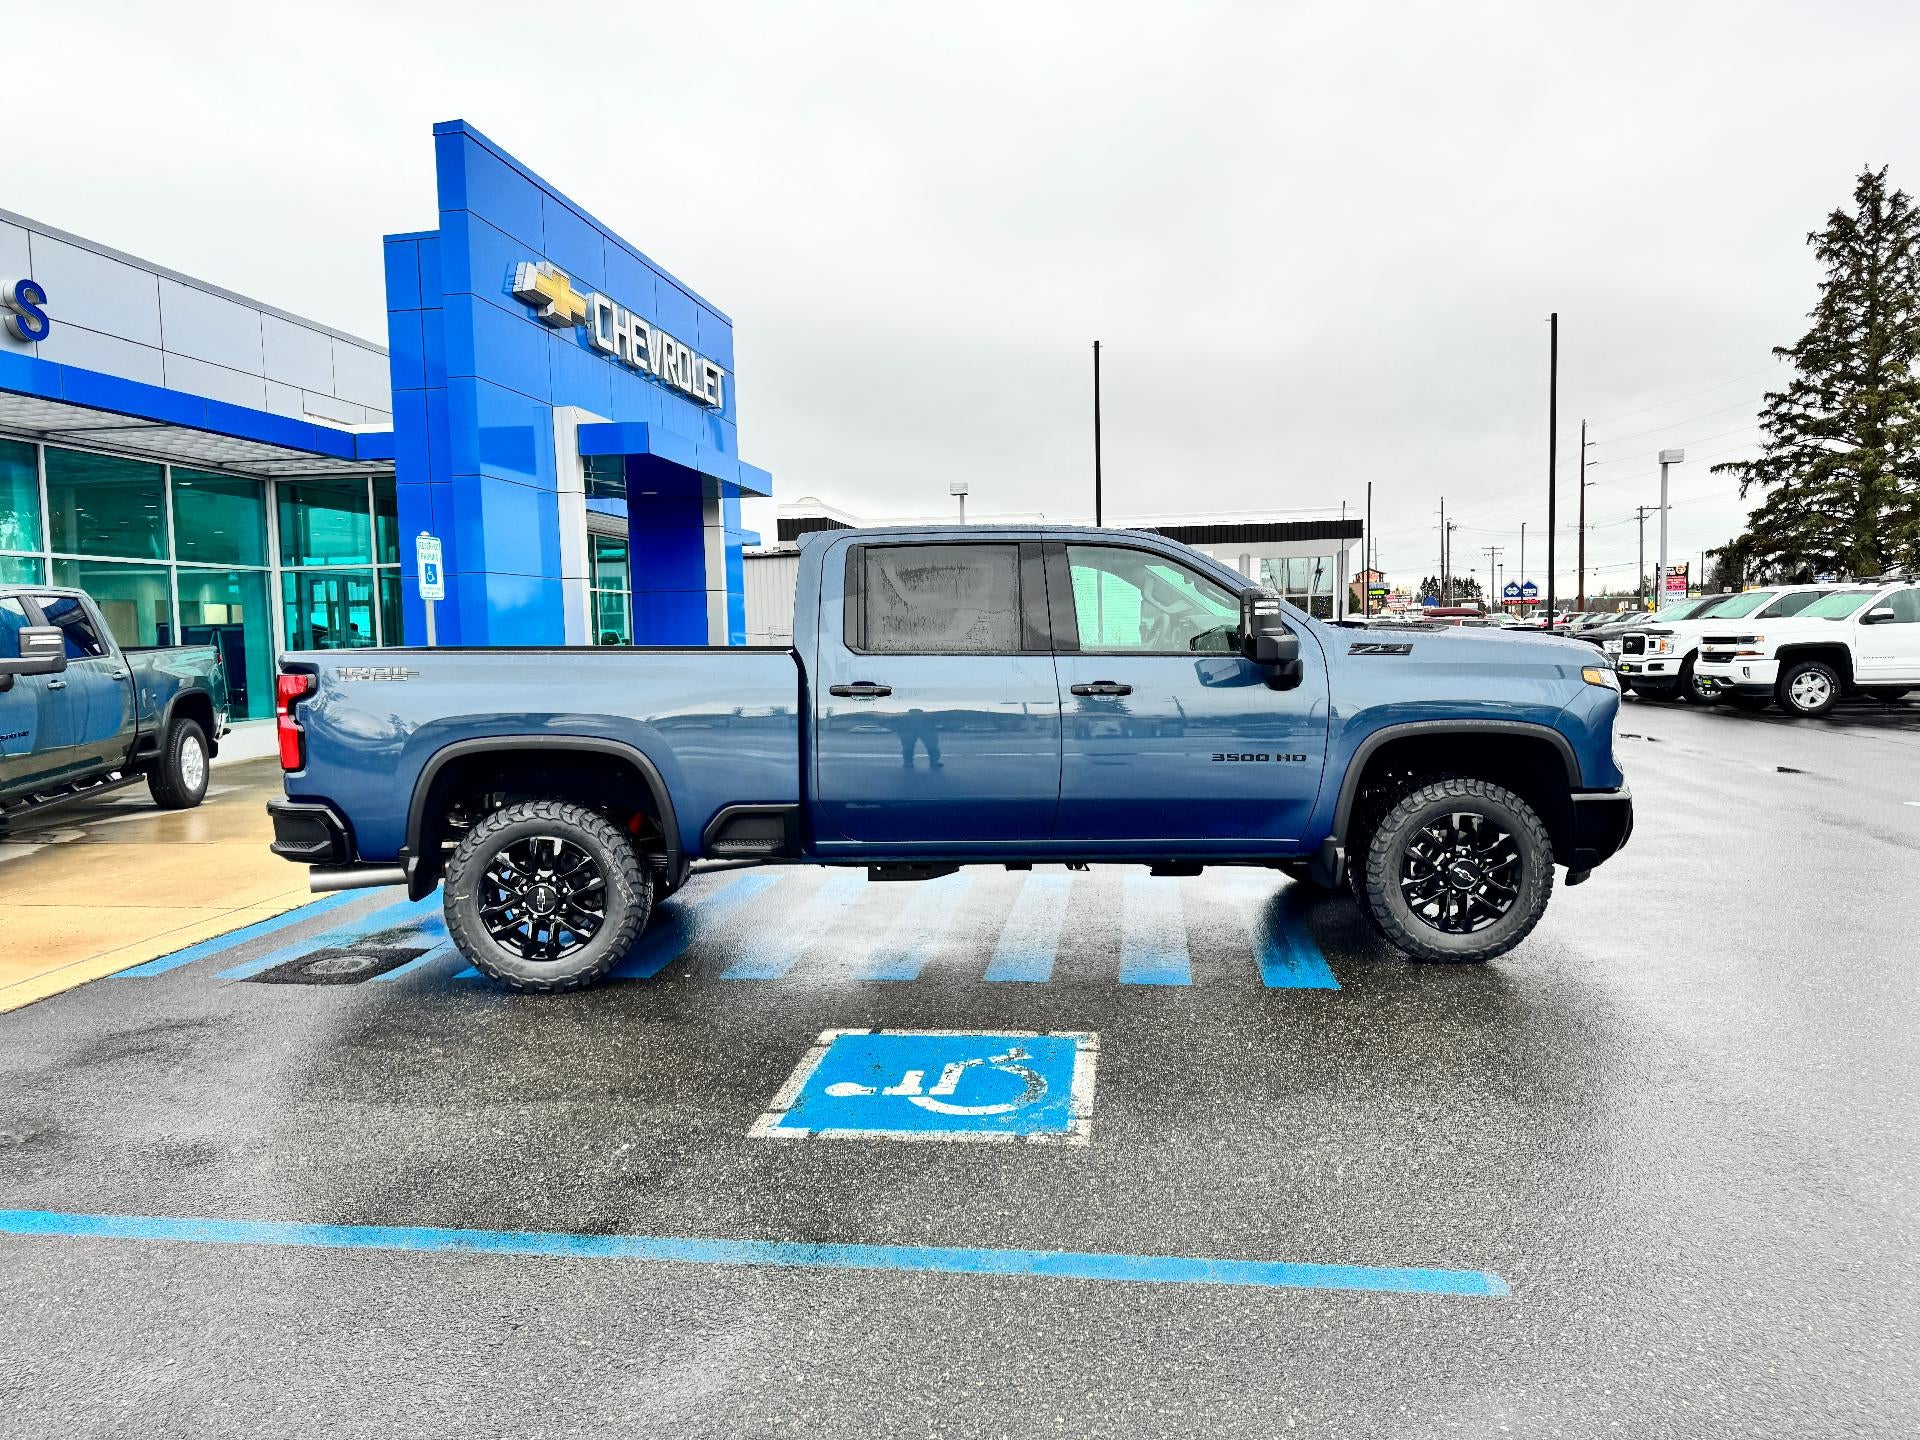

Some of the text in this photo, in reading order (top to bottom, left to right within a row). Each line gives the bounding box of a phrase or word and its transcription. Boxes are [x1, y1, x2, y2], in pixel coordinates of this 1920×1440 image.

[13, 279, 50, 342] S
[588, 292, 725, 408] CHEVROLET
[336, 667, 419, 675] TRAIL
[1212, 753, 1307, 762] 3500 HD
